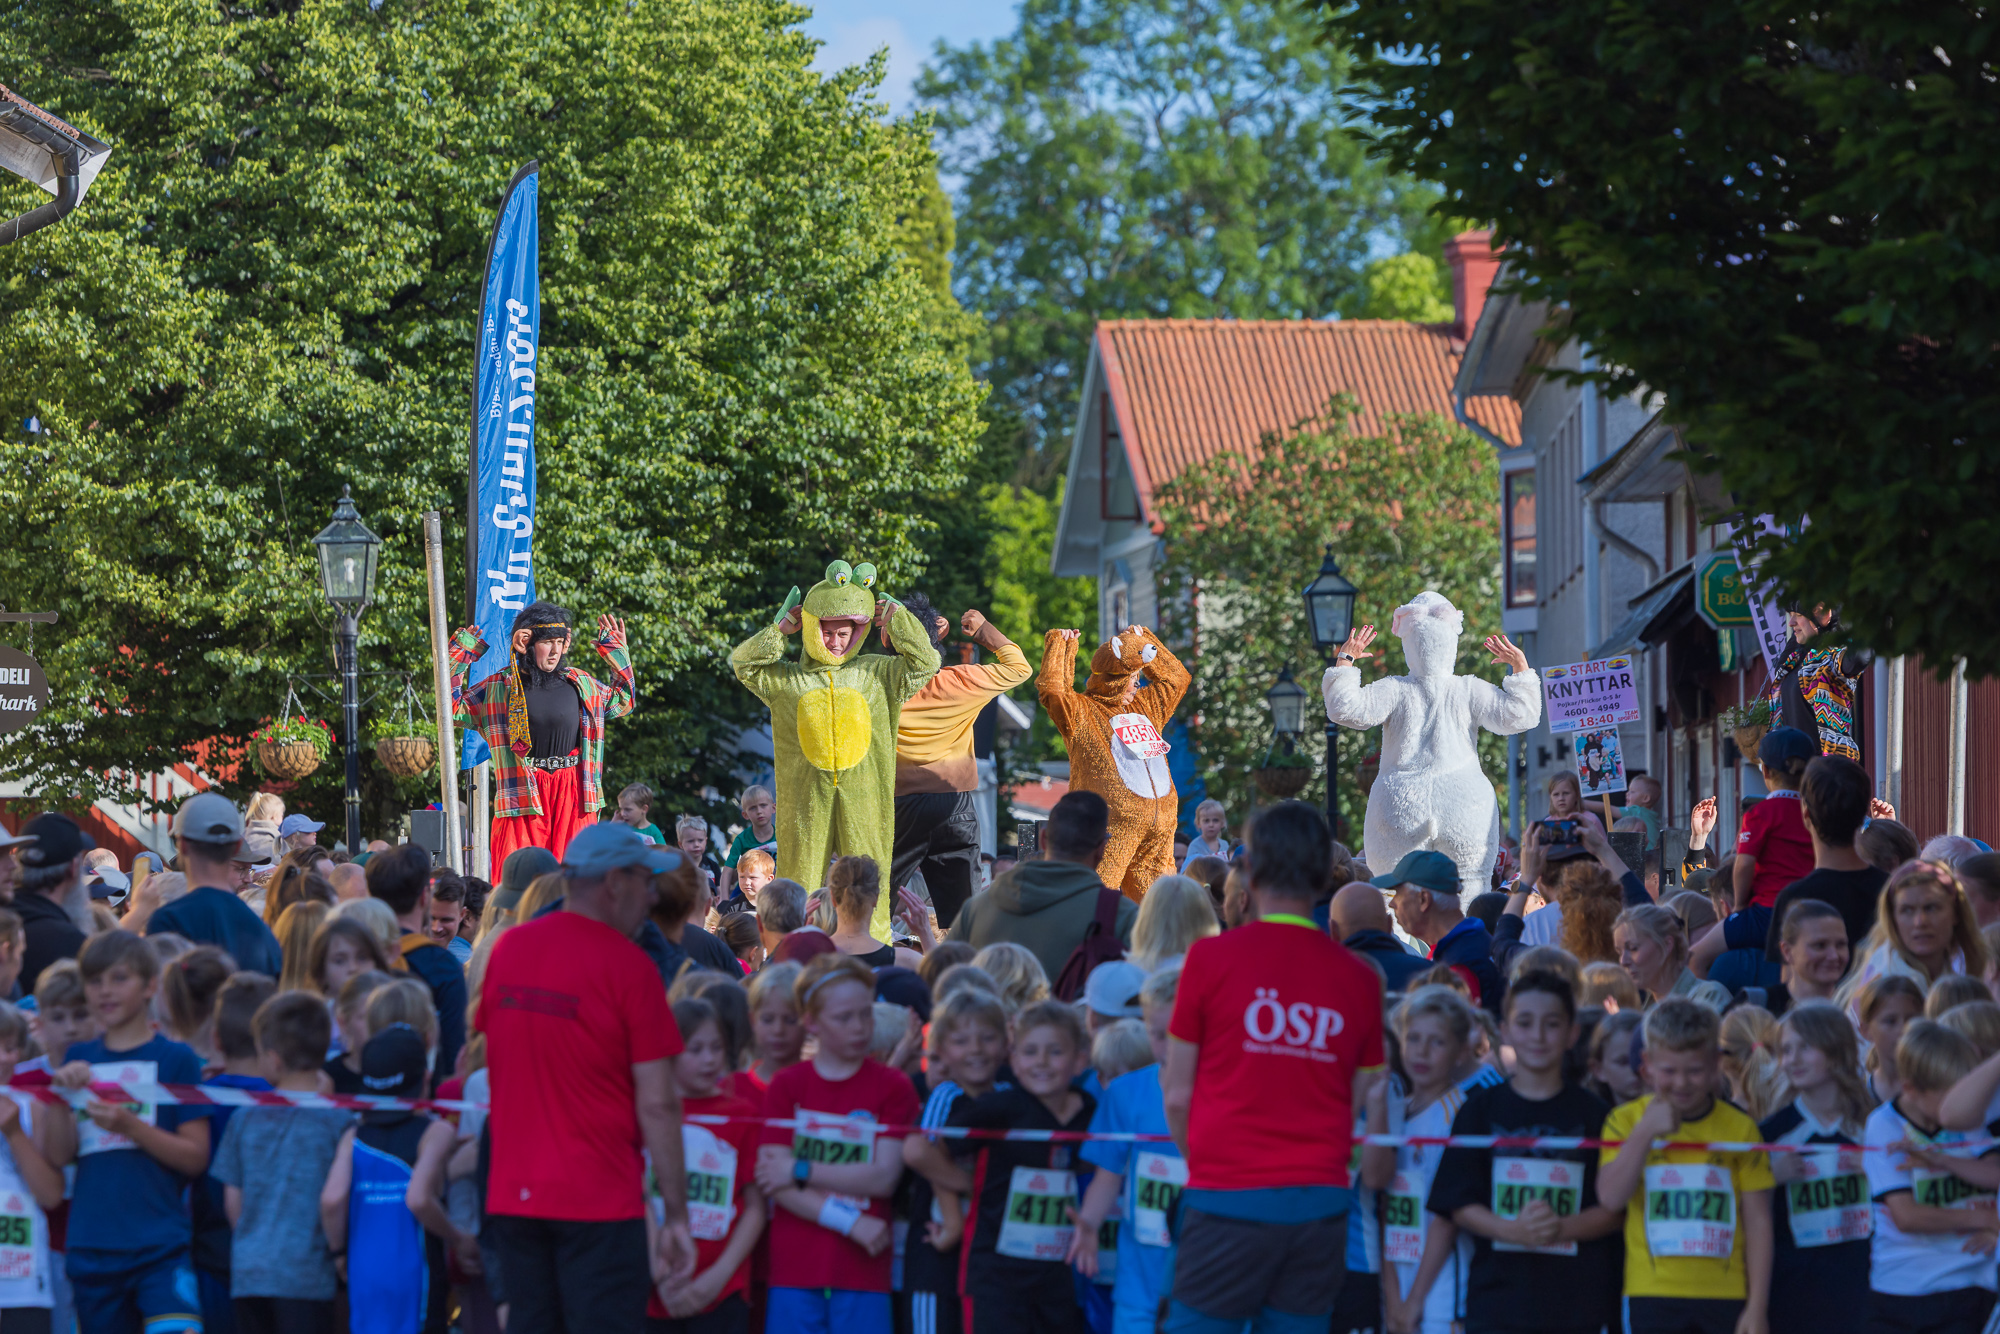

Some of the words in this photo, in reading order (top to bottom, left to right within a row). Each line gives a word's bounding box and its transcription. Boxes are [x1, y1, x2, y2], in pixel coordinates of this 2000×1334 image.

[0, 667, 30, 685] DELI
[1570, 661, 1606, 677] START
[1547, 672, 1633, 700] KNYTTAR
[1557, 697, 1602, 708] Pojkar/Flickor
[1564, 707, 1588, 717] 4600
[1597, 702, 1620, 711] 4949
[1579, 713, 1614, 728] 18:40
[1617, 714, 1639, 722] SPORTIA
[1122, 724, 1158, 743] 4850
[1243, 986, 1345, 1051] ÖSP
[1141, 1180, 1176, 1210] 40
[1798, 1175, 1861, 1211] 4050
[1015, 1194, 1076, 1225] 411
[1655, 1190, 1726, 1221] 4027
